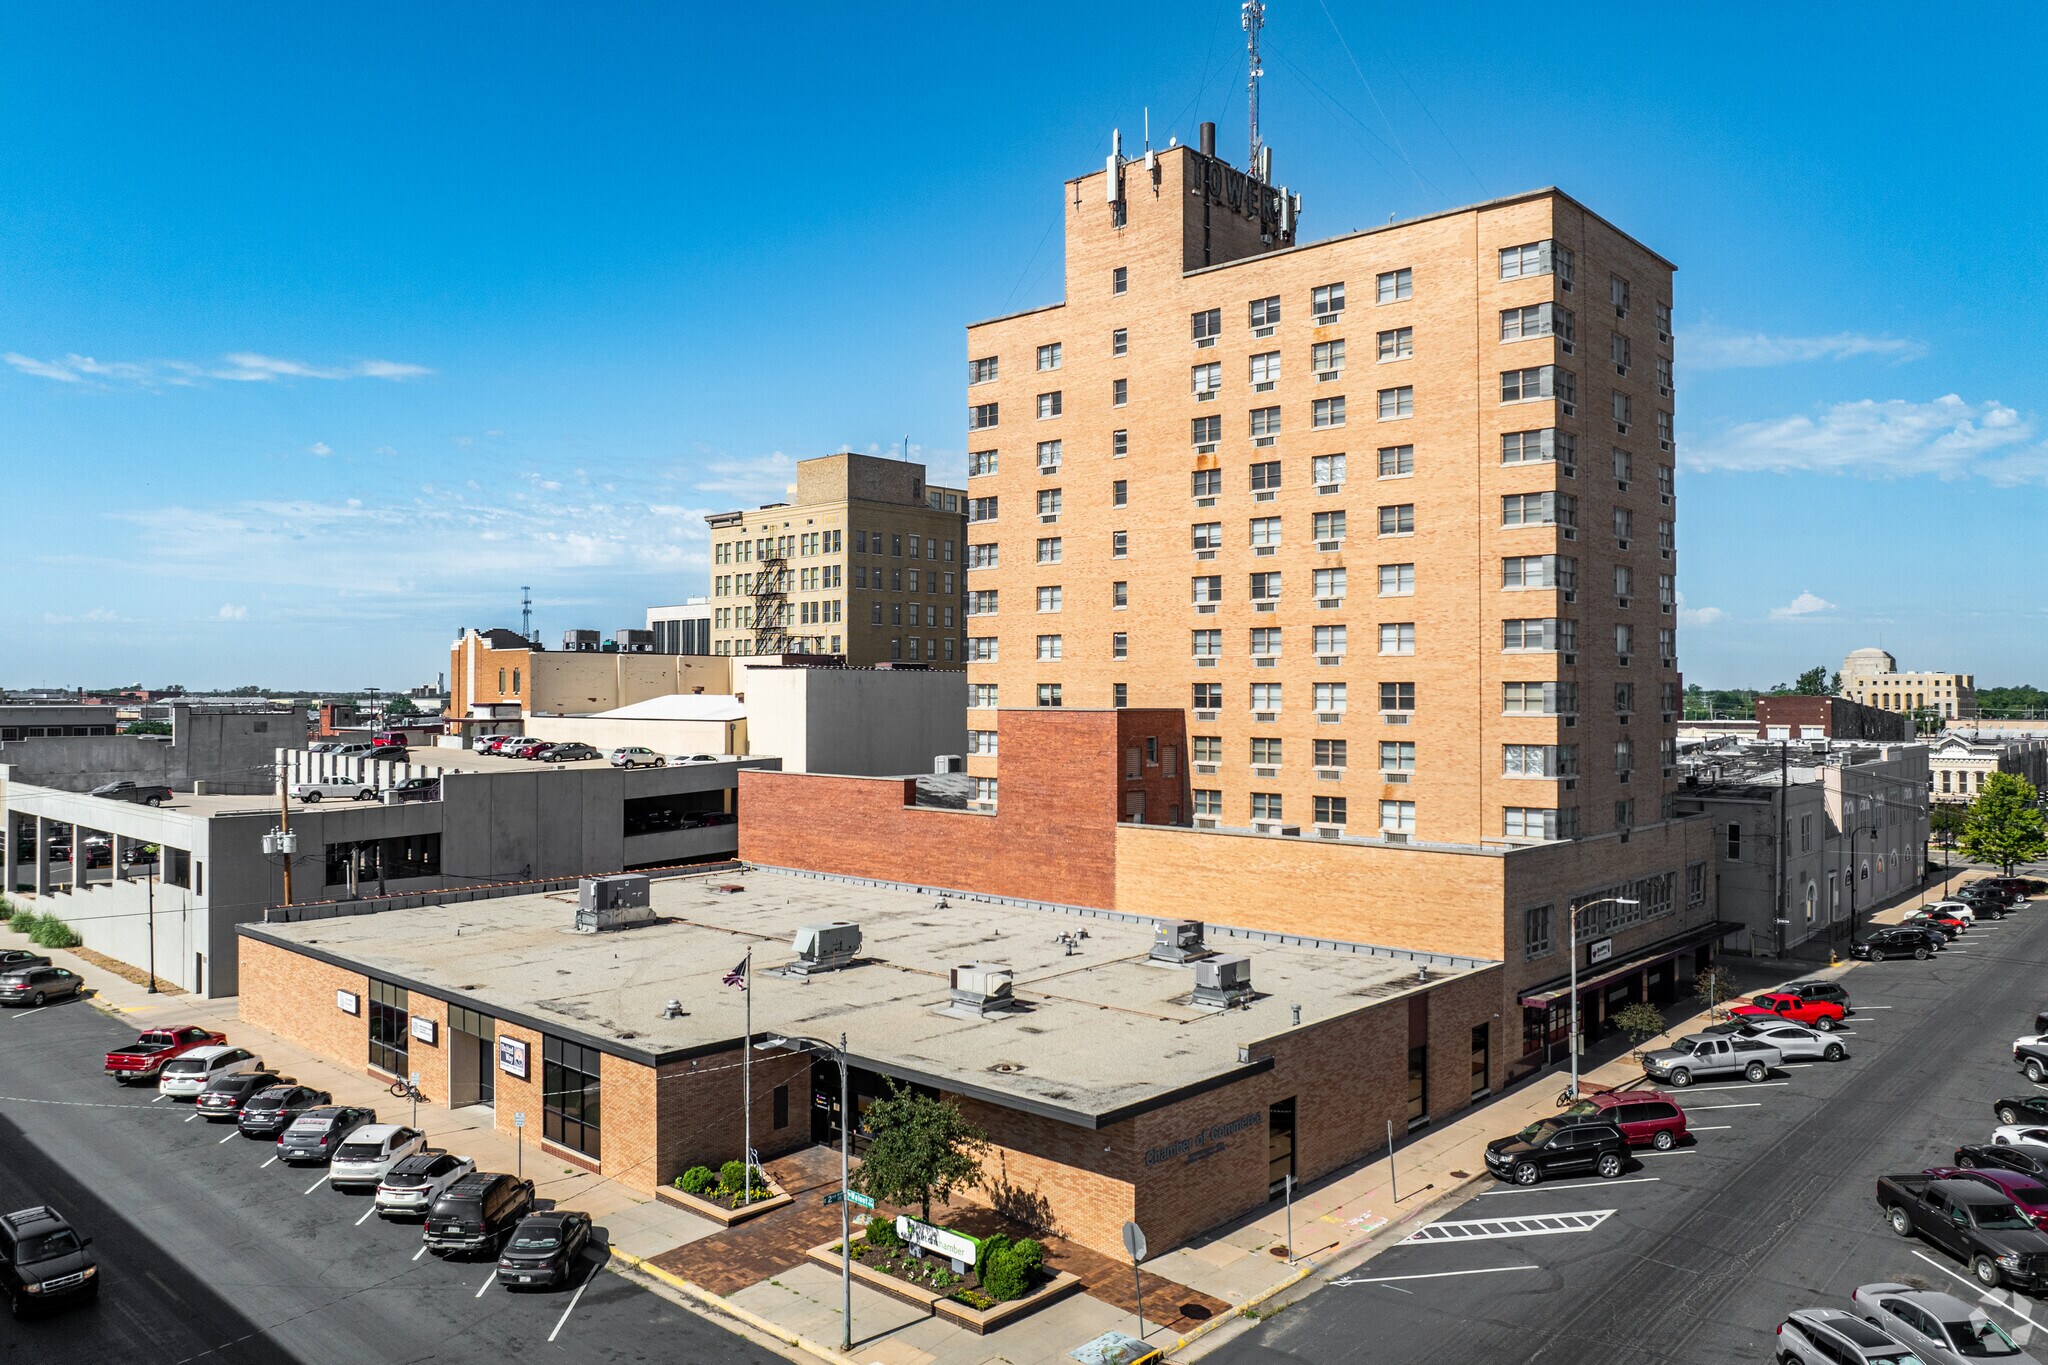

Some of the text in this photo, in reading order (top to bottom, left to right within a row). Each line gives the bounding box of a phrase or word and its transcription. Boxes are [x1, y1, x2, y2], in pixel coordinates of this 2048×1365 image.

[1190, 153, 1278, 224] TOWER
[1145, 1137, 1193, 1166] Chamber
[1195, 1129, 1207, 1147] of
[1209, 1111, 1263, 1141] Commerce
